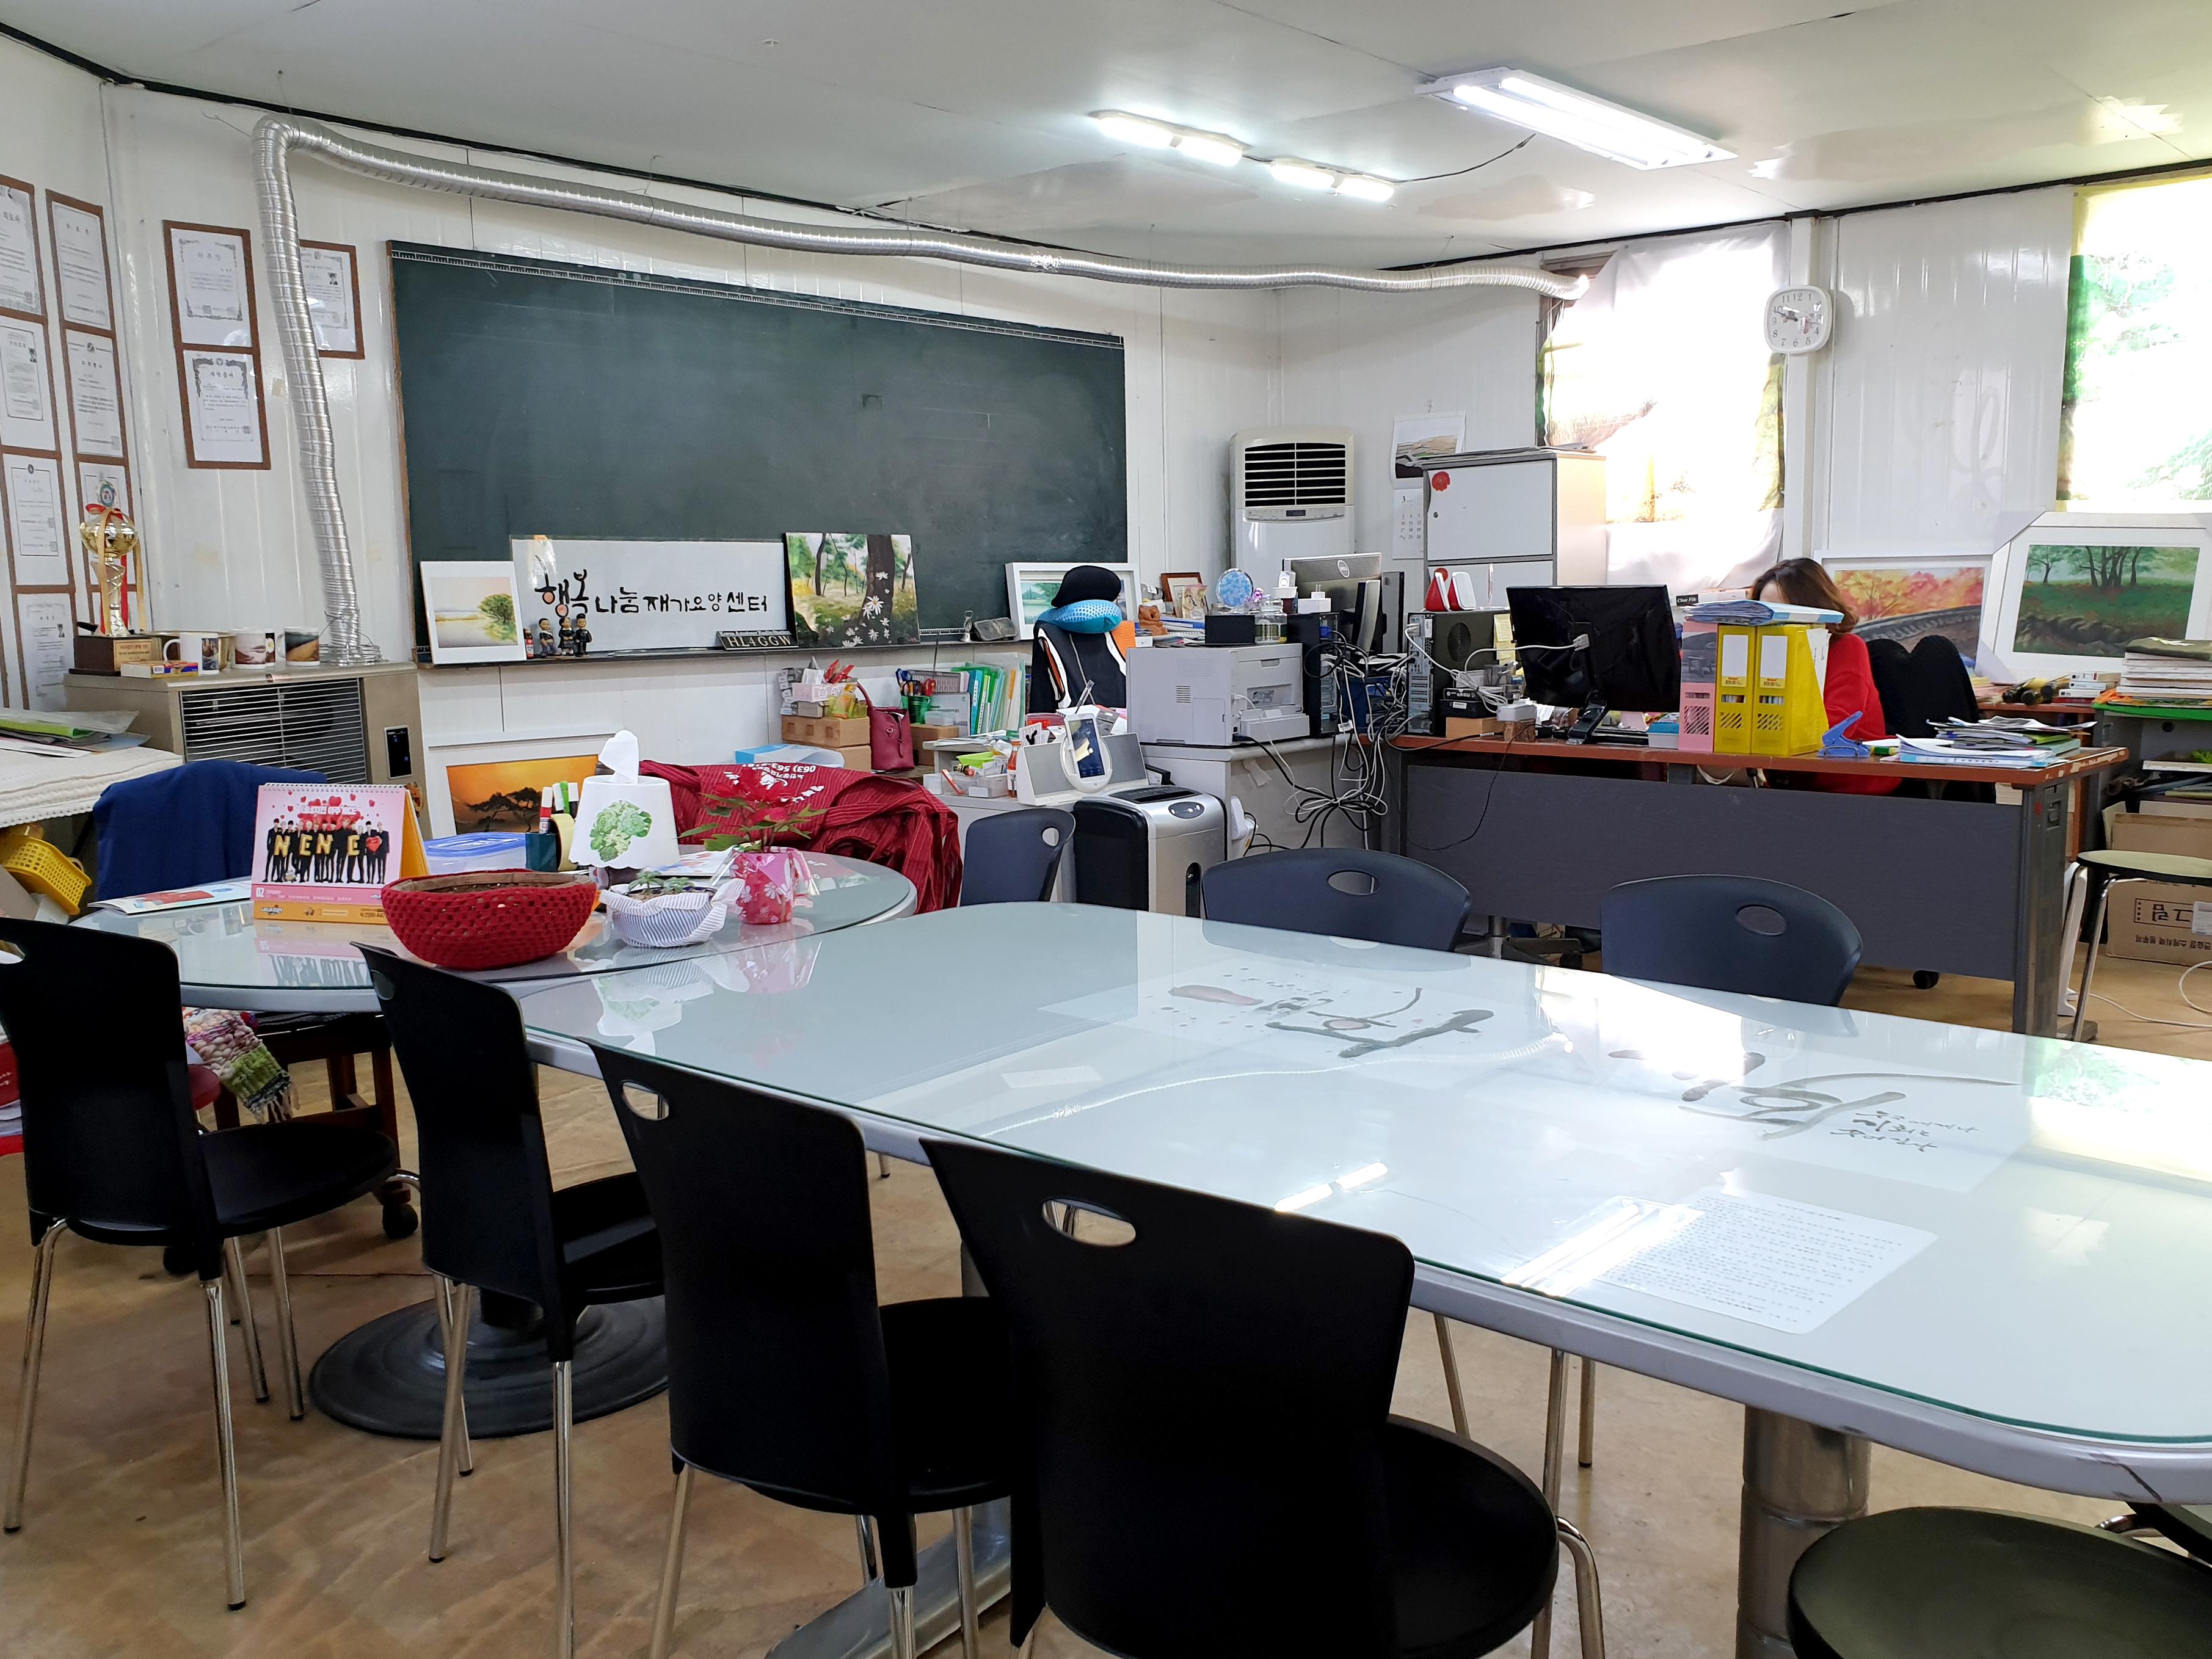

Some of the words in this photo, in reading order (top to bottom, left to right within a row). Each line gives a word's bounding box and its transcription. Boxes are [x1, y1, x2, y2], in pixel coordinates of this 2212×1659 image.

[1793, 292, 1803, 301] 12
[1814, 327, 1820, 335] 4
[1805, 337, 1811, 346] 5
[255, 887, 264, 898] 02
